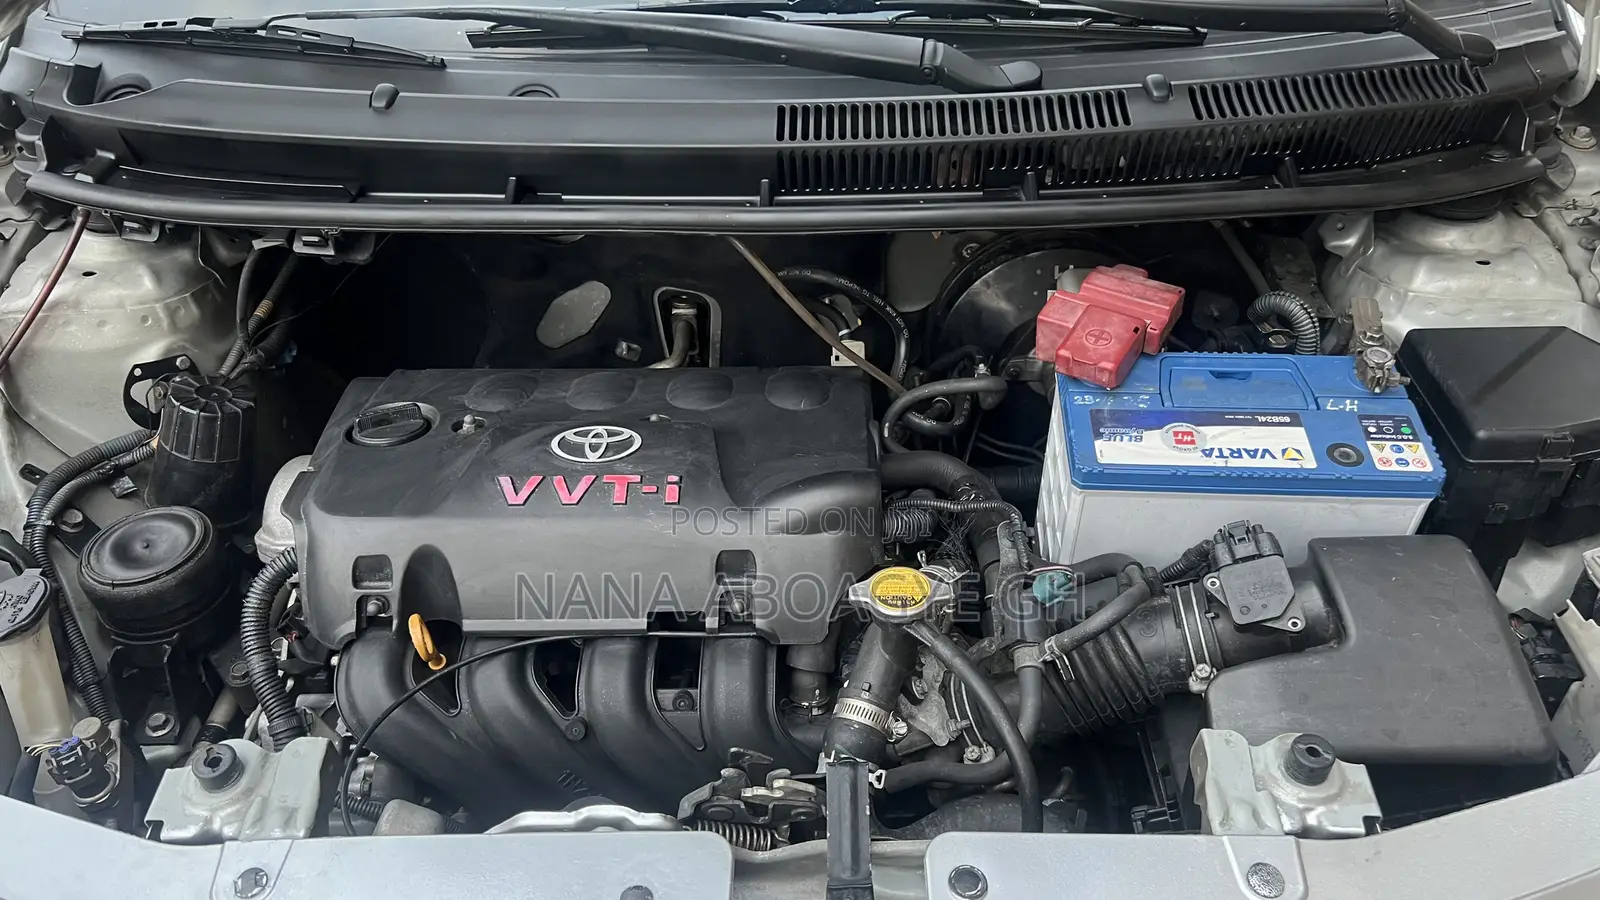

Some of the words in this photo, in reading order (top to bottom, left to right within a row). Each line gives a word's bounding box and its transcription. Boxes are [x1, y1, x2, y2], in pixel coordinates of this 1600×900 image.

[1102, 434, 1144, 442] BLUE
[1201, 448, 1278, 460] VARTA
[496, 475, 682, 506] VVT-i
